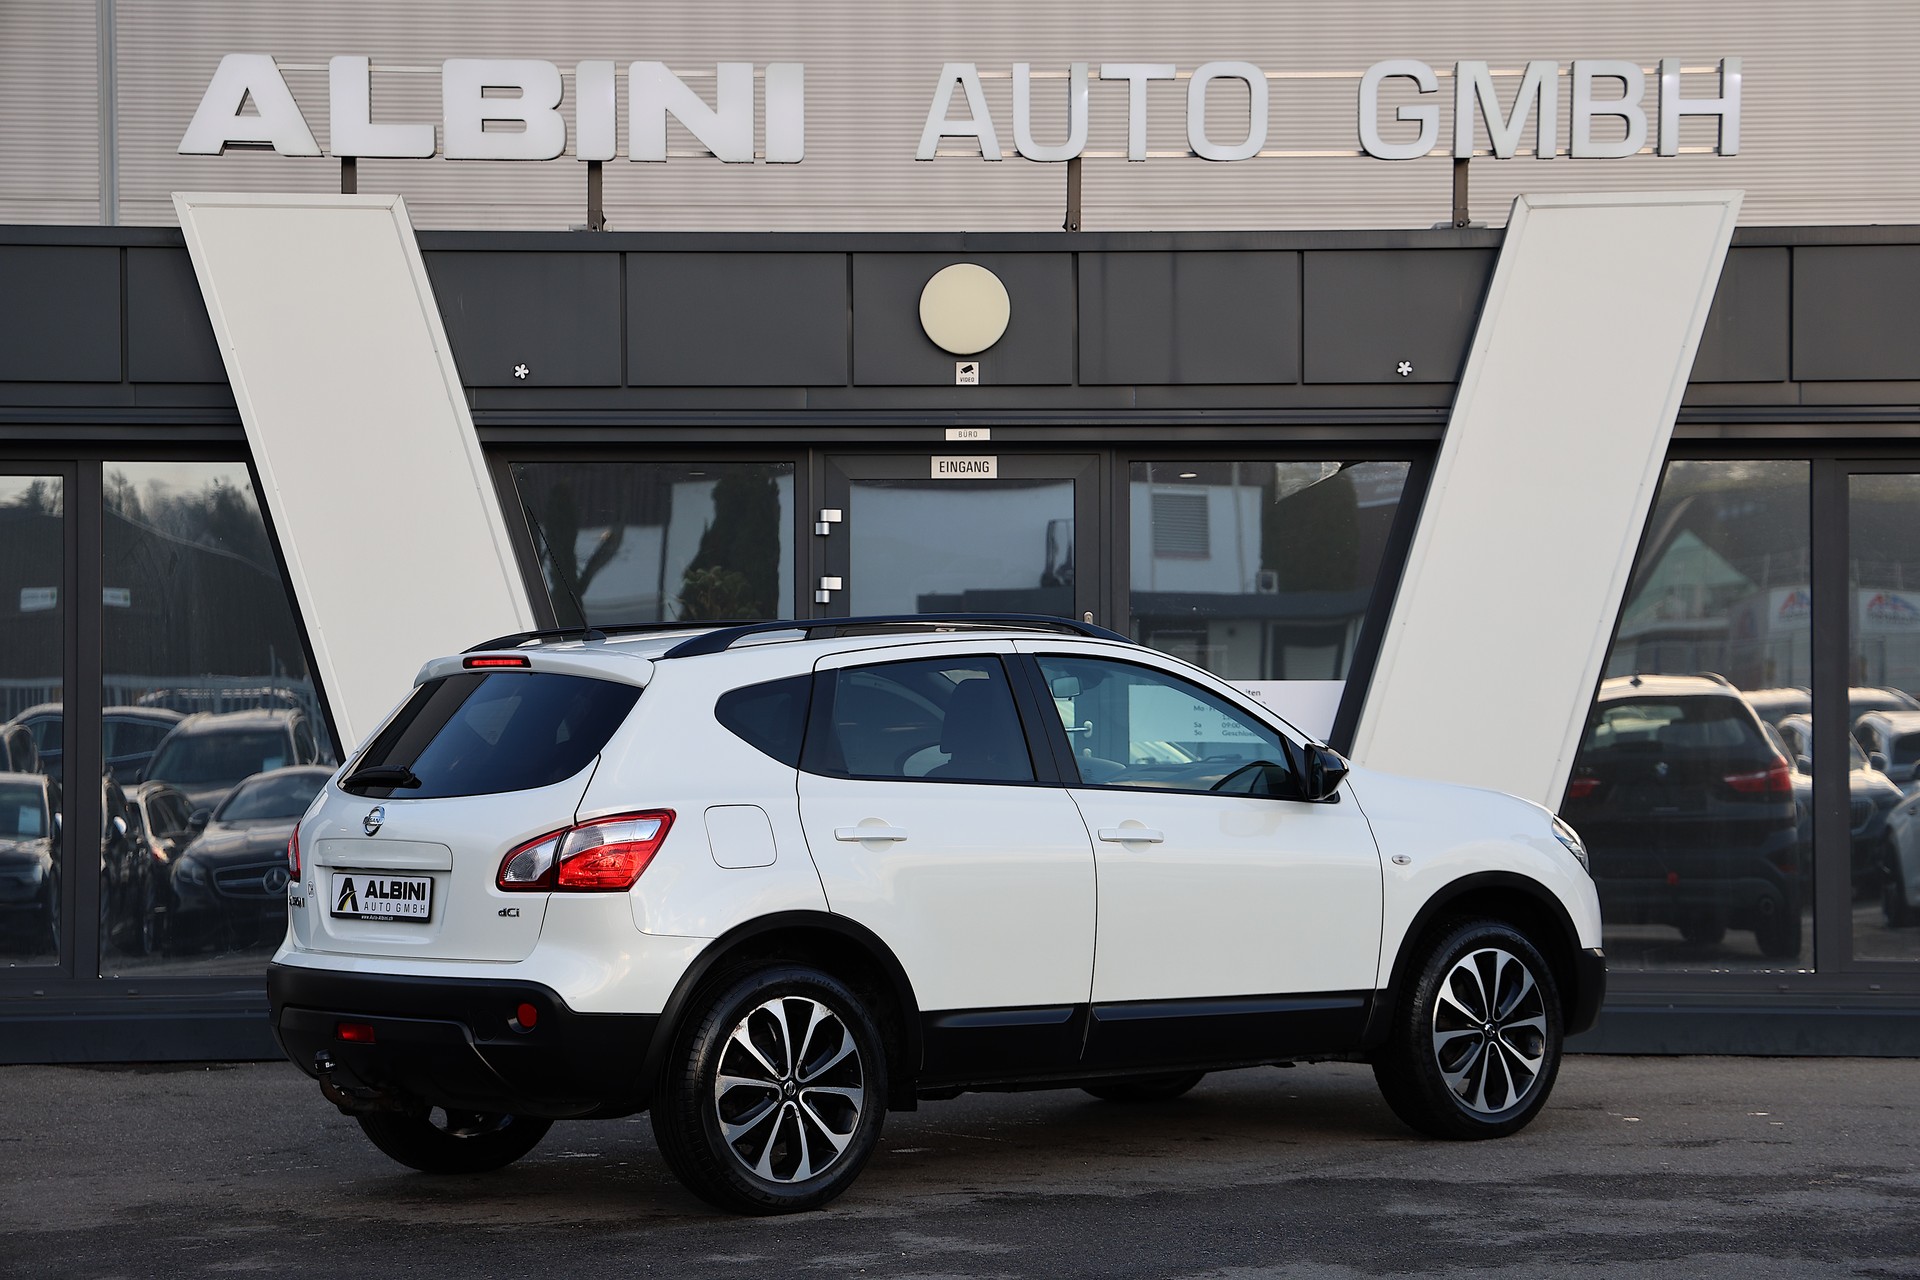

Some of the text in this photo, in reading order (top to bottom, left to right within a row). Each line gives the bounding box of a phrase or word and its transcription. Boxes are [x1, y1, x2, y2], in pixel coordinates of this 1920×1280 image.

[178, 53, 1742, 164] ALBINI AUTO GMBH
[958, 430, 978, 438] BÜRO
[939, 461, 990, 473] EINGANG
[364, 880, 427, 901] ALBINI
[363, 901, 426, 914] AUTO GMBH
[498, 907, 520, 917] dCi
